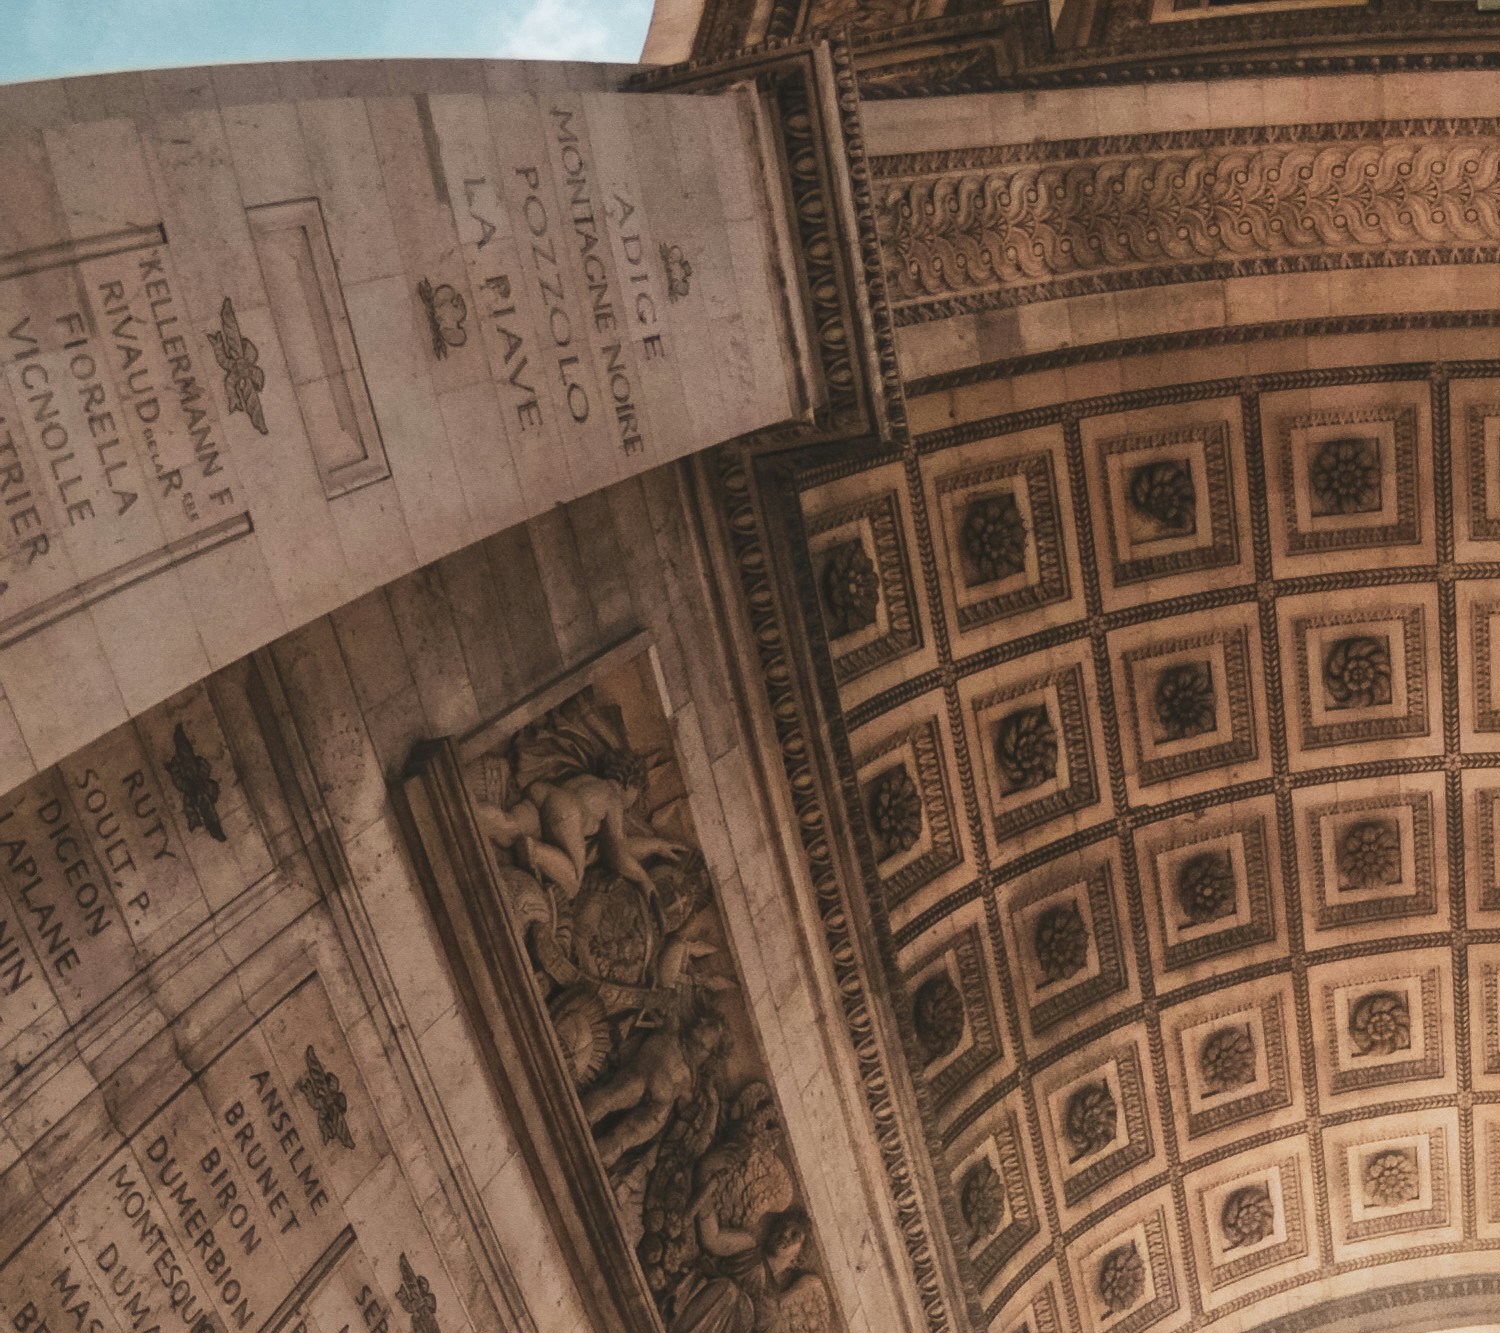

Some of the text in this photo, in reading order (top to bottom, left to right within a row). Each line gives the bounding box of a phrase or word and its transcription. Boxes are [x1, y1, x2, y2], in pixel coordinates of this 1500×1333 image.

[463, 176, 543, 431] LA PIAVE
[515, 166, 590, 424] POZZOLO
[552, 106, 644, 457] MONTAGNE NOIRE
[56, 313, 138, 515] FIORELLA
[122, 769, 177, 860] RUTY
[146, 1136, 255, 1331] DUMERBION
[200, 1147, 262, 1255] BIRON
[224, 1101, 300, 1235] BRUNET
[249, 1070, 328, 1216] ANSELME
